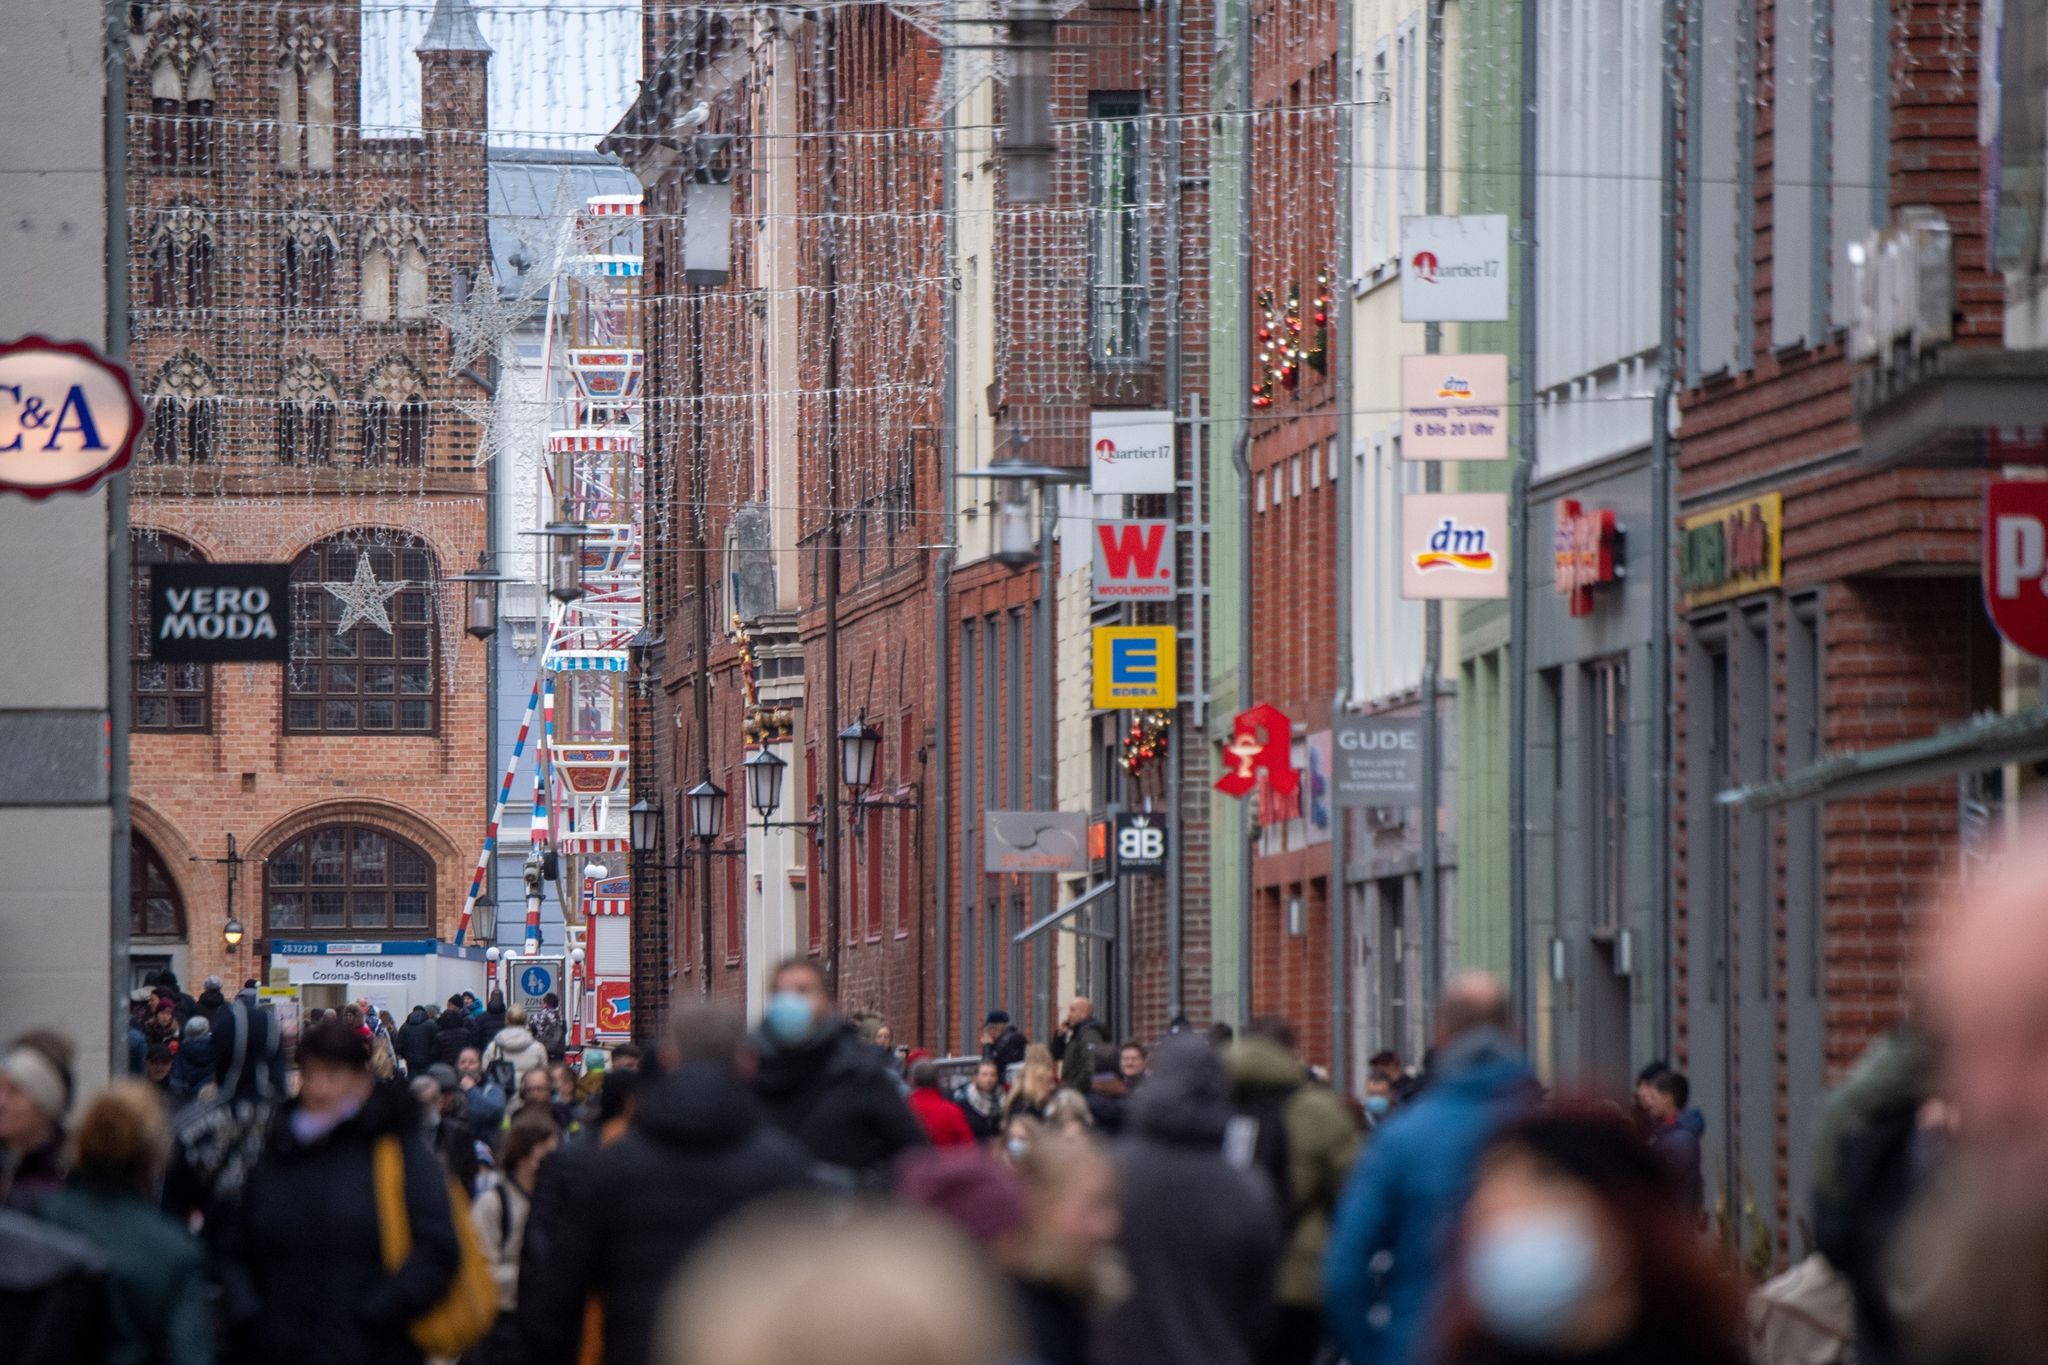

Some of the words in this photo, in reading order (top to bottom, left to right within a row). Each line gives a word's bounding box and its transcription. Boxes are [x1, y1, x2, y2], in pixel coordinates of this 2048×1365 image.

[1412, 251, 1500, 284] Quartier17
[1443, 376, 1469, 391] dm
[1414, 423, 1424, 436] 8
[1426, 422, 1446, 436] bis
[1450, 423, 1467, 436] 20
[1469, 422, 1495, 436] Uhr
[1096, 438, 1171, 464] Quartier17
[1430, 519, 1485, 553] dm
[164, 586, 270, 614] VERO
[1097, 585, 1170, 596] WOOLWORTH
[160, 612, 278, 640] MODA
[1112, 638, 1157, 684] E
[1112, 687, 1158, 697] EDEKA
[1338, 729, 1417, 751] GUDE
[335, 958, 394, 968] Kostenlose
[312, 971, 417, 981] Corona-Schnelltests
